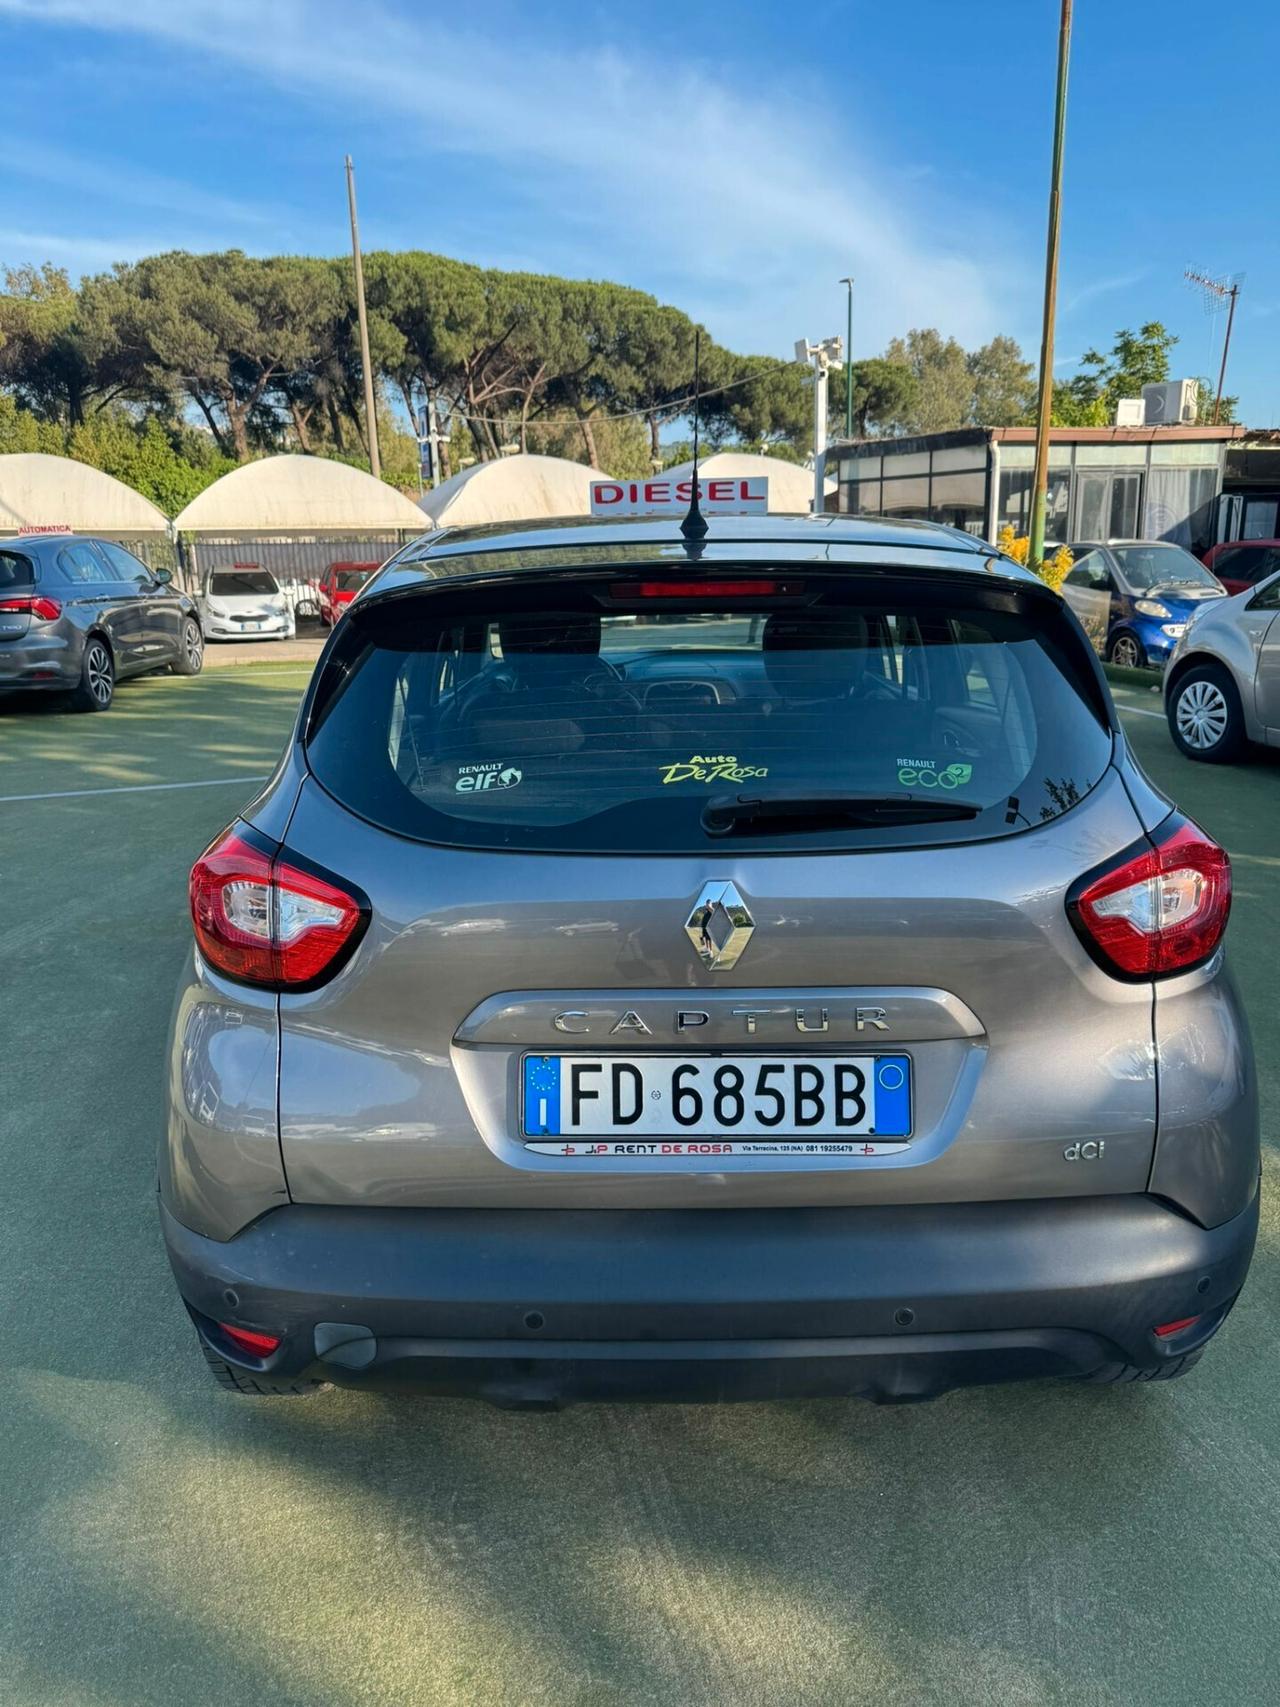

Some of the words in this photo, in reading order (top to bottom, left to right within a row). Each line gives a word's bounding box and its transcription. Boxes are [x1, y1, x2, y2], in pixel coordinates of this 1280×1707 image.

[593, 481, 766, 504] DIESEL
[18, 525, 71, 534] AUTOMATICA
[689, 755, 737, 763] Auto
[896, 758, 936, 769] RENAULT
[458, 763, 504, 775] RENAULT
[455, 771, 498, 792] elf
[553, 1007, 890, 1036] CAPTUR
[571, 1063, 643, 1126] FD
[672, 1063, 866, 1127] 685BB
[614, 1144, 657, 1154] RENT
[661, 1144, 683, 1154] DE
[687, 1144, 733, 1154] ROSA
